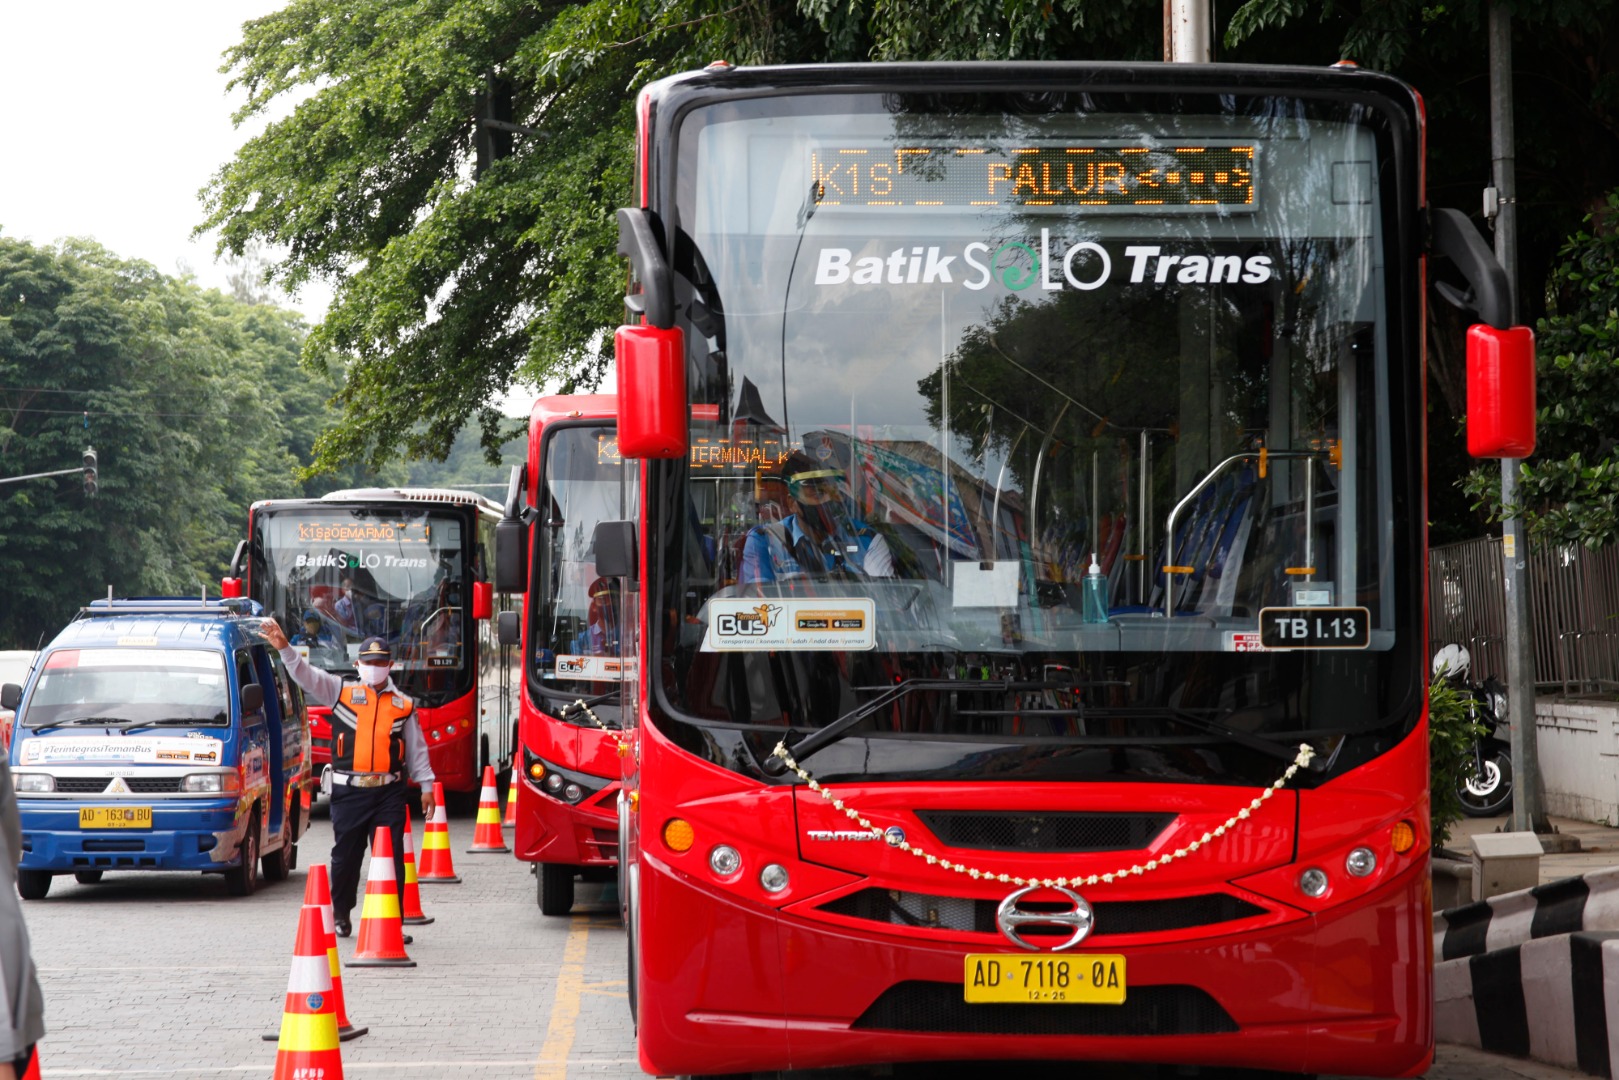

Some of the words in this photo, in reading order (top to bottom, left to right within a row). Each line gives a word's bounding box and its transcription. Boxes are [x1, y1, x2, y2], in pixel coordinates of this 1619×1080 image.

[814, 246, 957, 286] Batik
[1124, 245, 1273, 284] Trans
[691, 446, 773, 464] TERMINAL
[295, 554, 337, 567] Batik
[384, 554, 427, 568] Trans
[1275, 618, 1308, 639] TB
[44, 744, 152, 754] #TerintegrasiTemanBus
[82, 809, 94, 821] AD
[106, 809, 134, 820] 163
[137, 809, 150, 820] BU
[807, 830, 881, 841] TENTREM
[974, 960, 1000, 987] AD
[1020, 962, 1070, 988] 7118
